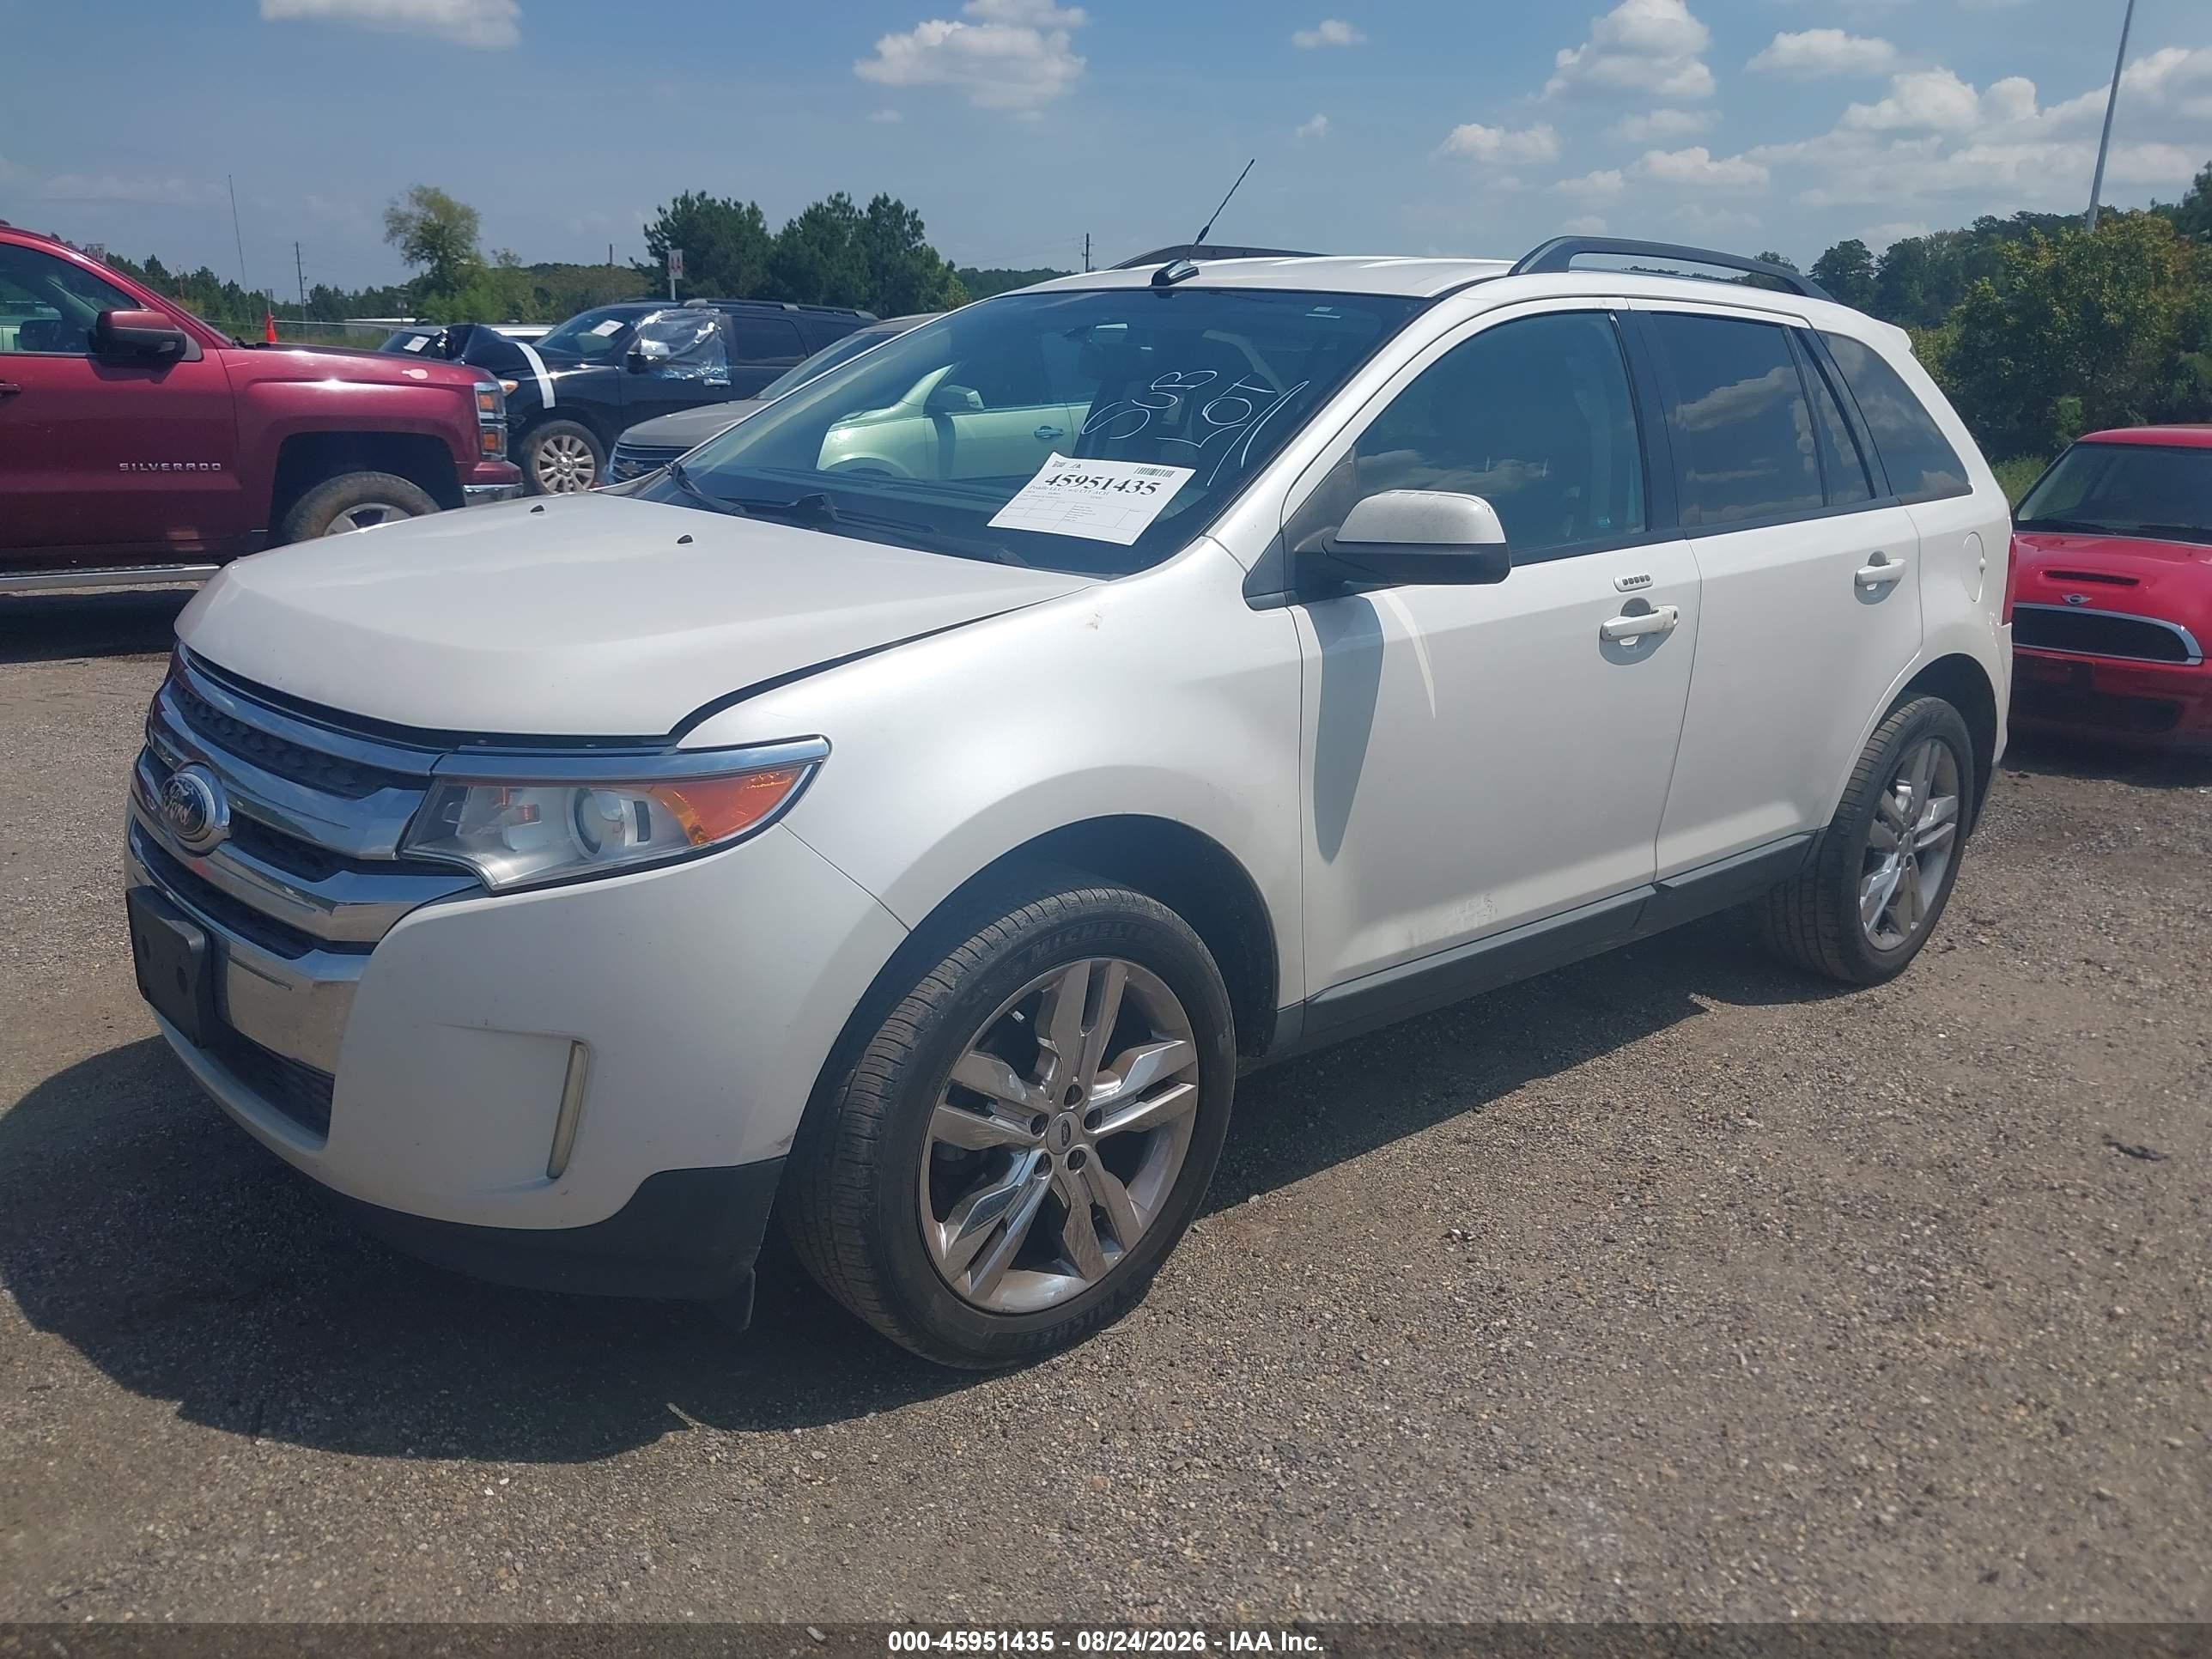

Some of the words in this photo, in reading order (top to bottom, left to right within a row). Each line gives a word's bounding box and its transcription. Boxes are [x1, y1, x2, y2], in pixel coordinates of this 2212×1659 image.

[1080, 370, 1218, 440] SUB
[1155, 374, 1277, 448] LOT
[118, 462, 222, 471] SILVERADO
[1044, 473, 1162, 495] 45951435
